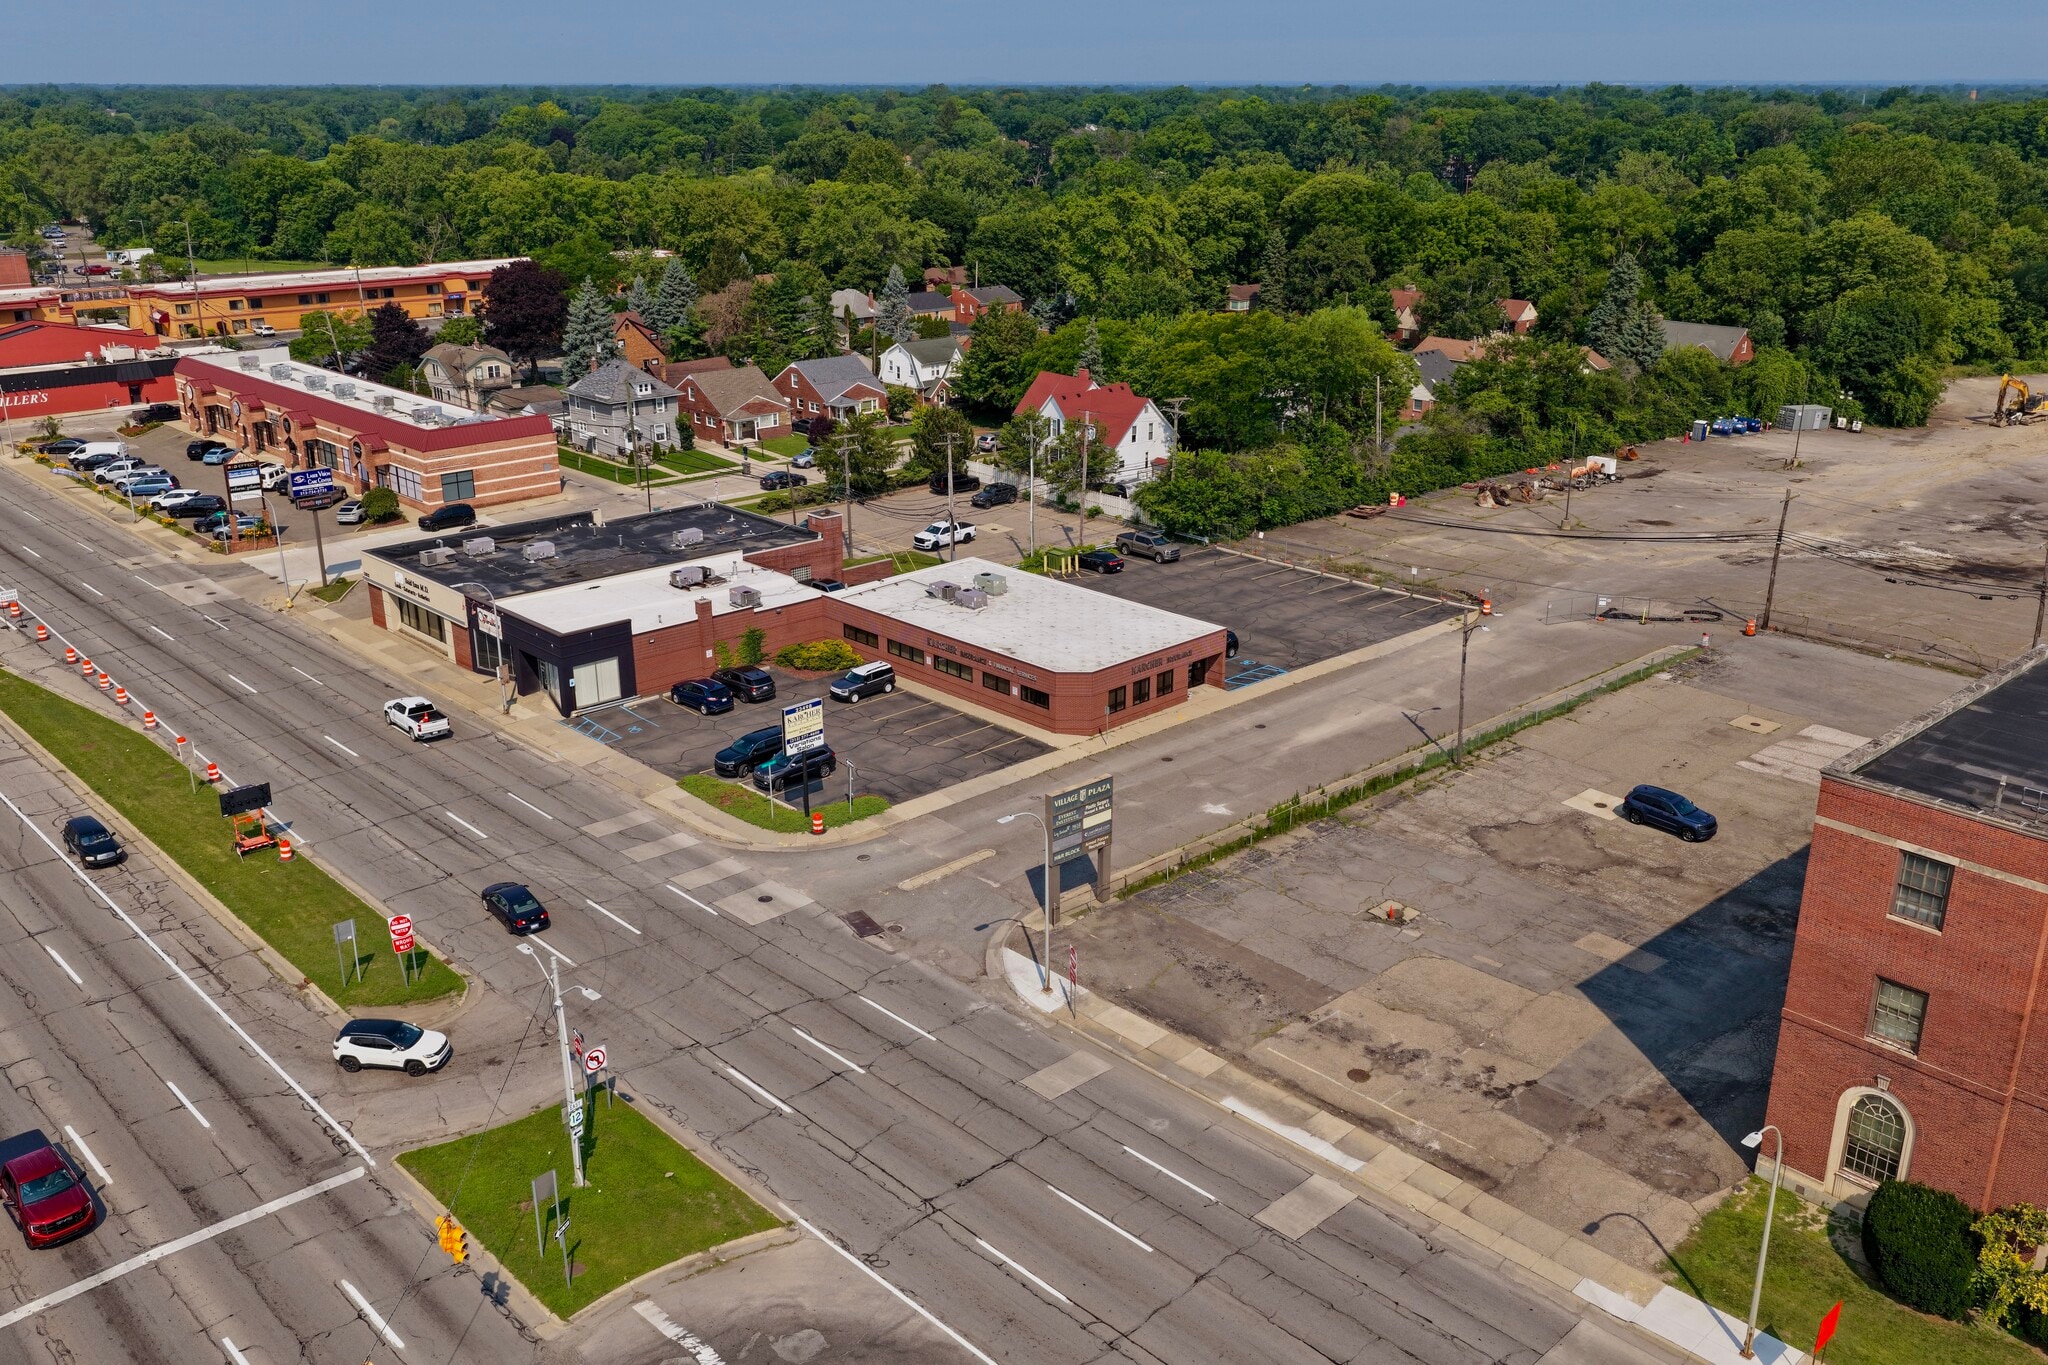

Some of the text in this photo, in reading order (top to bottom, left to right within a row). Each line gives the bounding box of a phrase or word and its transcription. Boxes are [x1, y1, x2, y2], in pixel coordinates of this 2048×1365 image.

[789, 736, 822, 749] Variations
[797, 743, 814, 752] Salon
[1054, 784, 1111, 807] VILLAGE PLAZA
[1065, 848, 1080, 857] BLOCK
[395, 937, 412, 946] WRONG
[569, 1102, 581, 1111] EAST
[571, 1112, 581, 1124] 12
